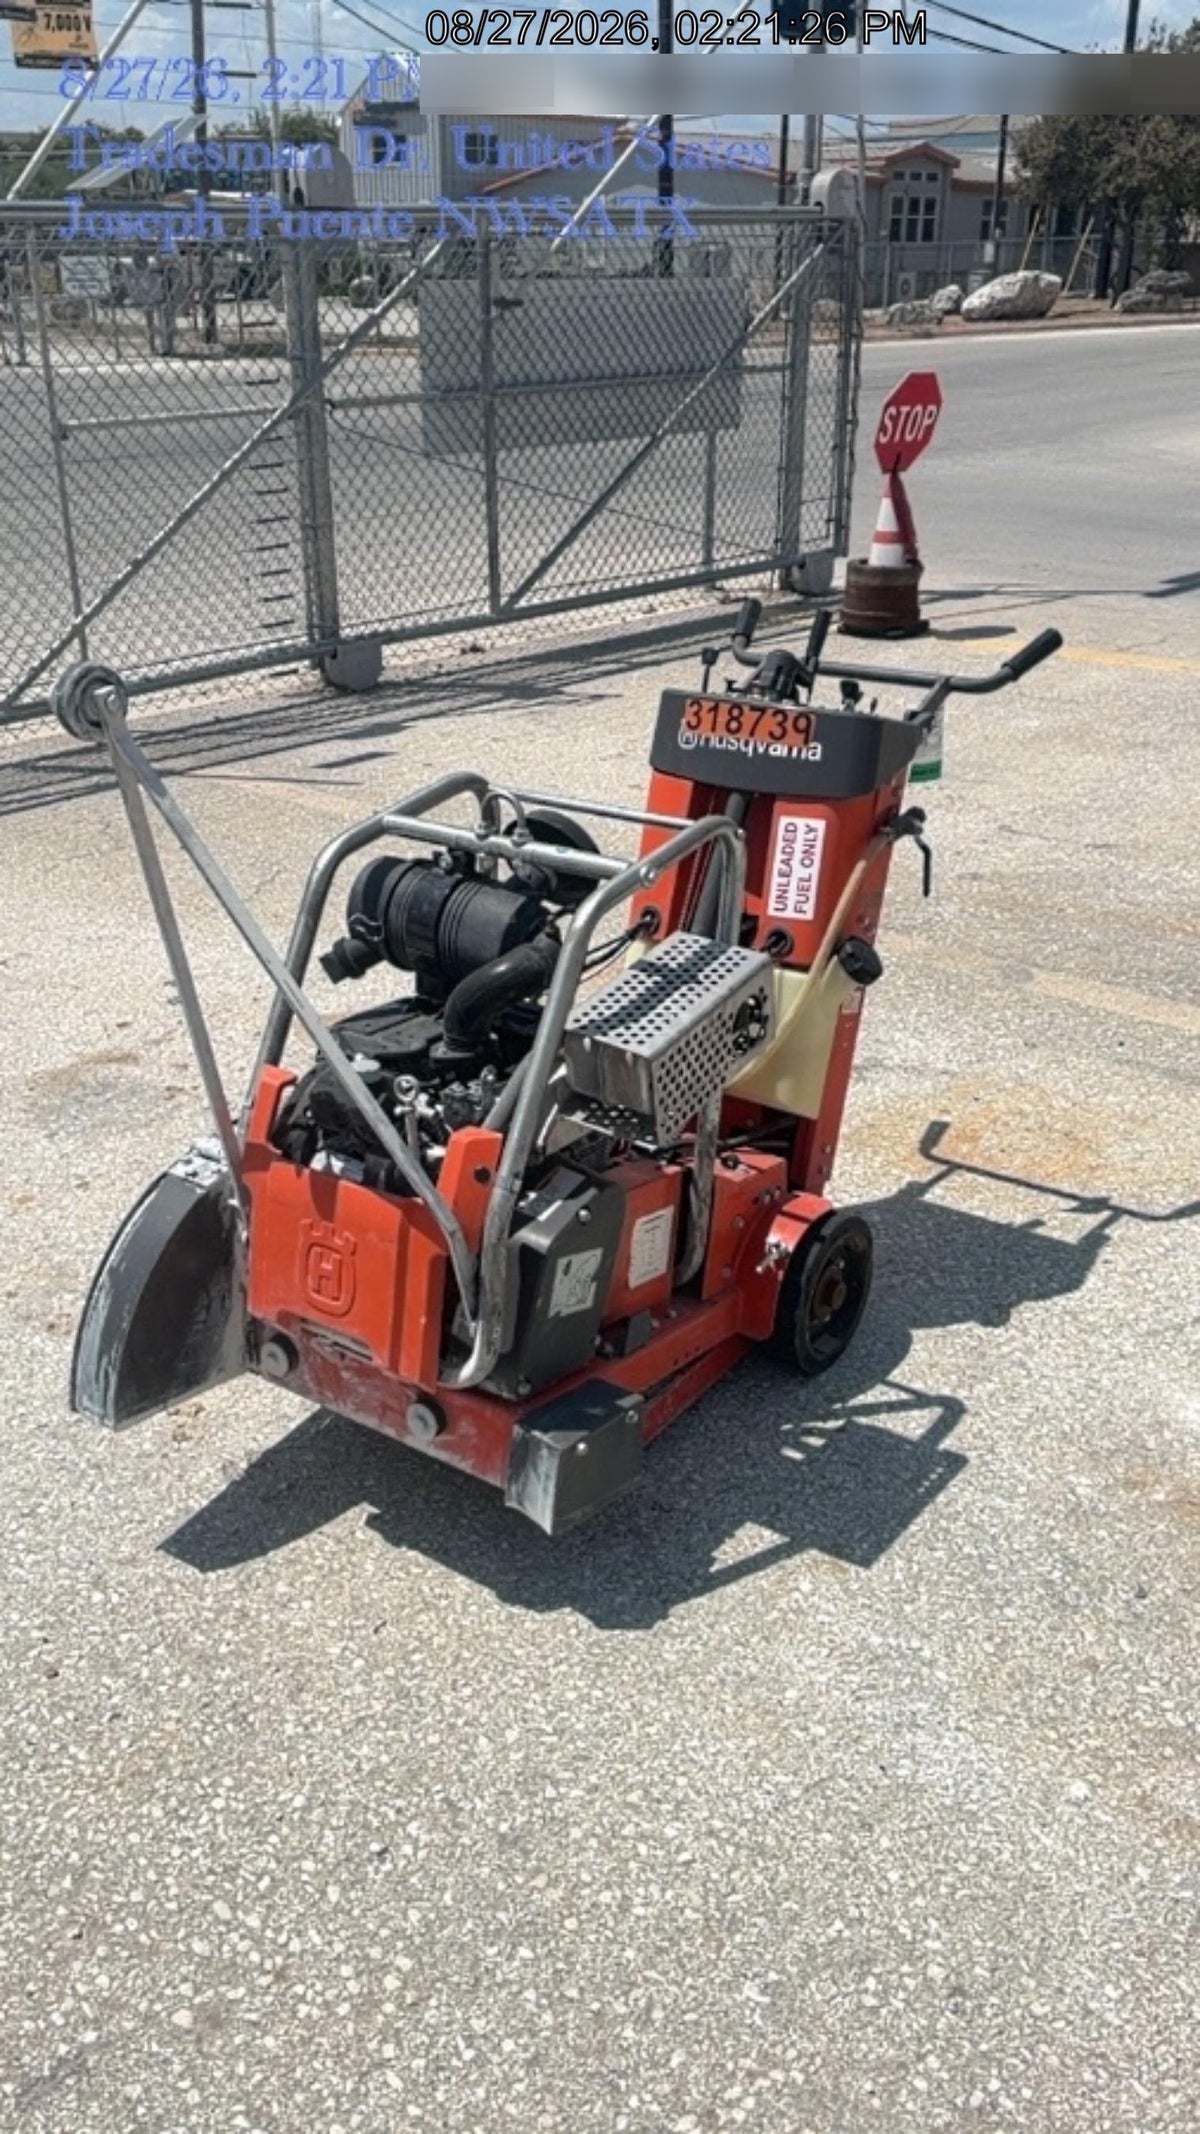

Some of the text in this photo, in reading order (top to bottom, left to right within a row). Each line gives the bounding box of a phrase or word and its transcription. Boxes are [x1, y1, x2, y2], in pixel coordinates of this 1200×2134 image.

[878, 404, 938, 445] STOP
[686, 699, 813, 746] 318739
[773, 822, 798, 913] UNLEADED
[794, 823, 819, 915] FUEL ONLY
